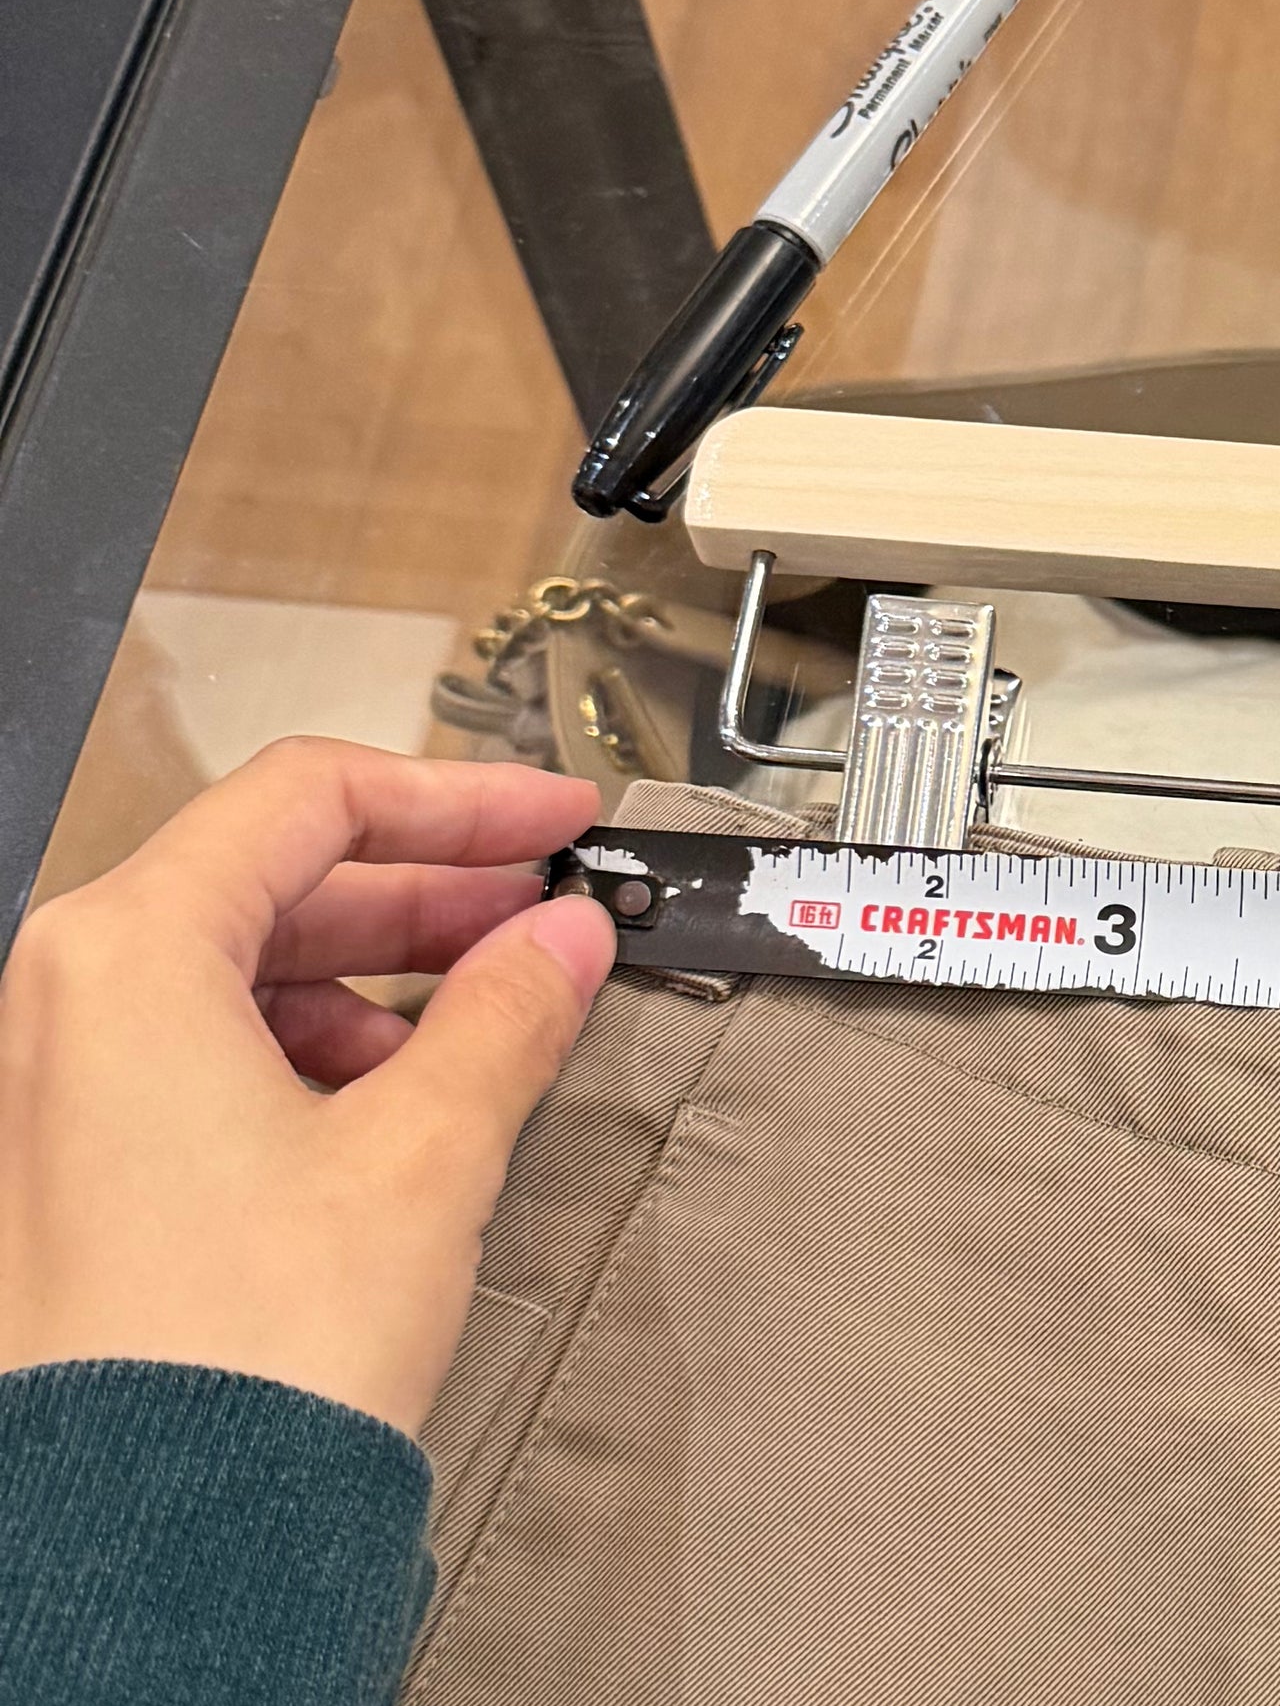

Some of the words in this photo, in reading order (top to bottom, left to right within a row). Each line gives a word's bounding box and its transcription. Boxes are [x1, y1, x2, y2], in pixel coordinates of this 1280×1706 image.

[857, 59, 912, 119] Permanent
[908, 12, 944, 52] Marker
[925, 875, 944, 898] 2
[1093, 904, 1138, 955] 3
[917, 939, 937, 960] 2
